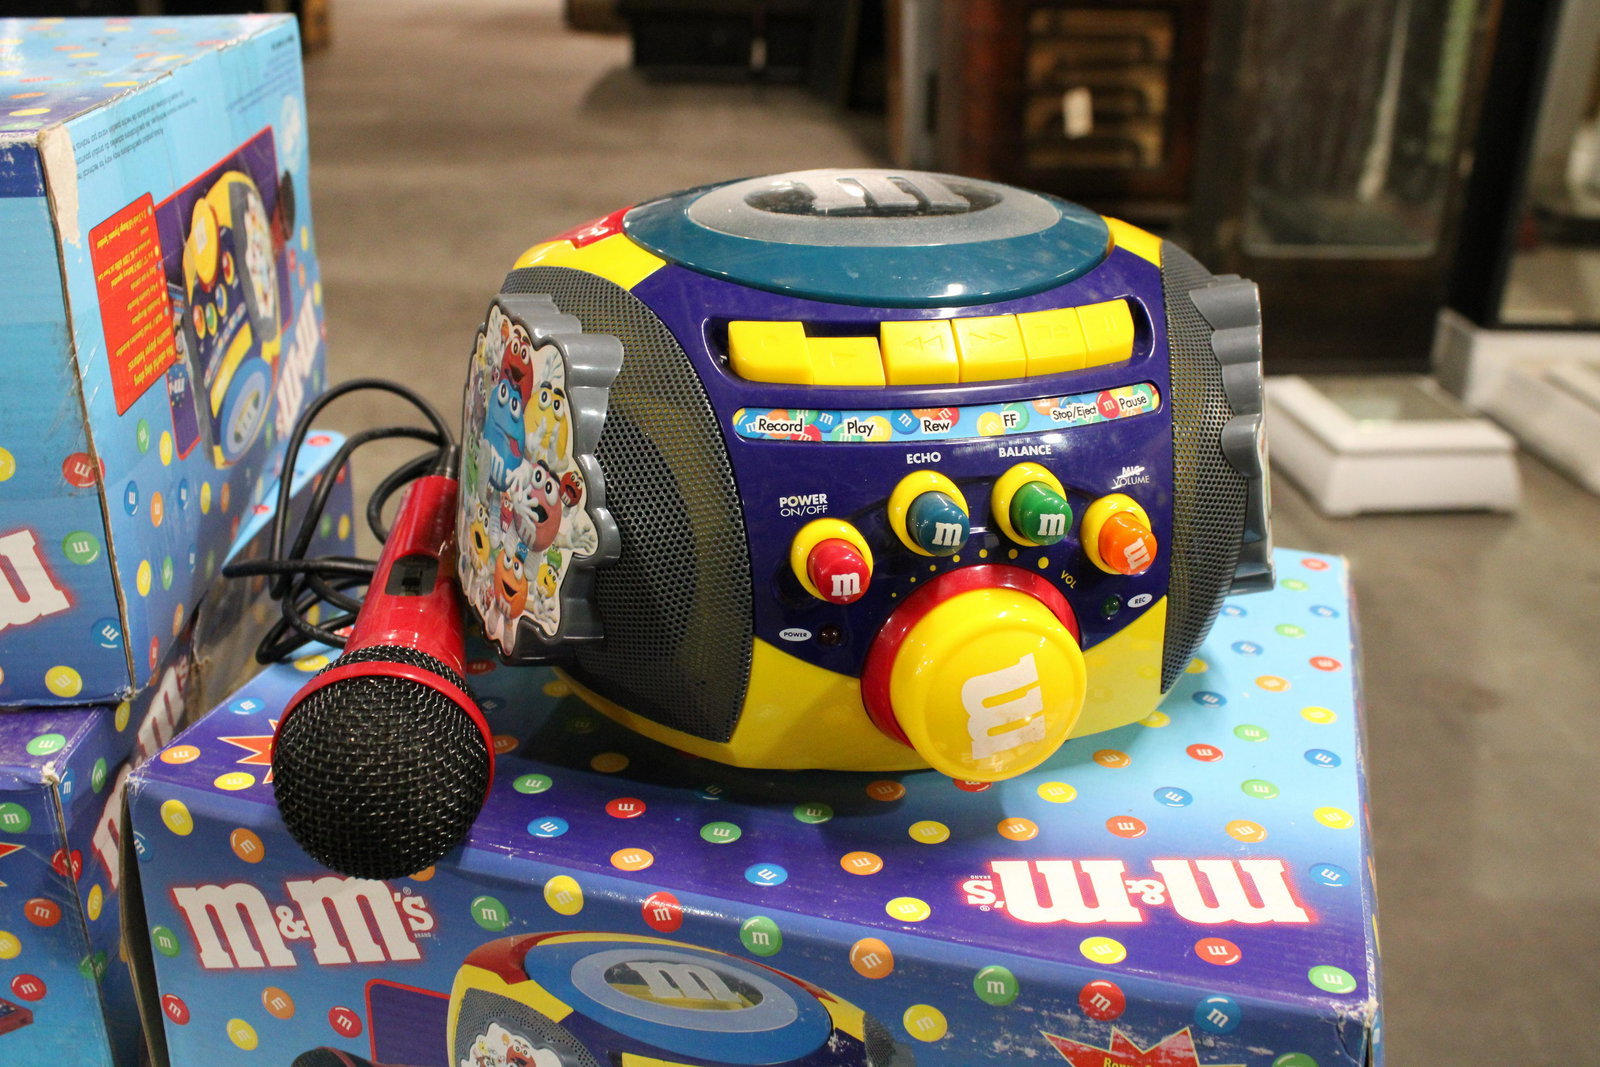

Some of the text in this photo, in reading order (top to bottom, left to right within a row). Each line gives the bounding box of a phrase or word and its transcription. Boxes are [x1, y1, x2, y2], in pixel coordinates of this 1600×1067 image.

[1103, 400, 1115, 410] m
[759, 395, 1147, 436] Record Play Rew FF Stop/Eject Pause
[820, 413, 833, 425] m
[899, 414, 912, 427] m
[998, 445, 1051, 457] BALANCE
[906, 452, 941, 464] ECHO
[1113, 475, 1150, 486] VOLUME
[779, 493, 828, 508] POWER
[780, 504, 828, 517] ON/OFF
[1037, 513, 1066, 536] m
[932, 522, 963, 546] m
[72, 540, 91, 553] m
[1123, 537, 1150, 570] m
[831, 572, 861, 596] m
[1061, 570, 1077, 589] VOL
[102, 625, 119, 640] m
[55, 675, 71, 688] m
[961, 652, 1046, 760] m
[525, 780, 542, 788] m
[1165, 792, 1184, 803] m
[618, 802, 635, 811] m
[806, 808, 823, 817] m
[4, 812, 20, 823] m
[540, 822, 557, 833] m
[713, 827, 730, 837] m
[1009, 824, 1027, 833] m
[1118, 821, 1136, 831] m
[240, 838, 256, 853] m
[623, 854, 642, 864] m
[852, 857, 871, 867] m
[758, 869, 777, 880] m
[1322, 870, 1340, 882] m
[555, 890, 573, 904] m
[35, 906, 50, 919] m
[482, 907, 497, 921] m
[654, 903, 671, 921] m
[900, 904, 916, 914] m
[158, 936, 171, 948] m
[752, 930, 770, 946] m
[1093, 943, 1113, 955] m
[1207, 944, 1229, 956] m
[861, 951, 882, 968] m
[1323, 974, 1343, 985] m
[21, 982, 37, 993] m
[987, 979, 1005, 995] m
[272, 997, 286, 1010] m
[1090, 991, 1111, 1011] m
[168, 1004, 182, 1017] m
[337, 1014, 352, 1029] m
[916, 1015, 934, 1030] m
[1208, 1008, 1229, 1028] m
